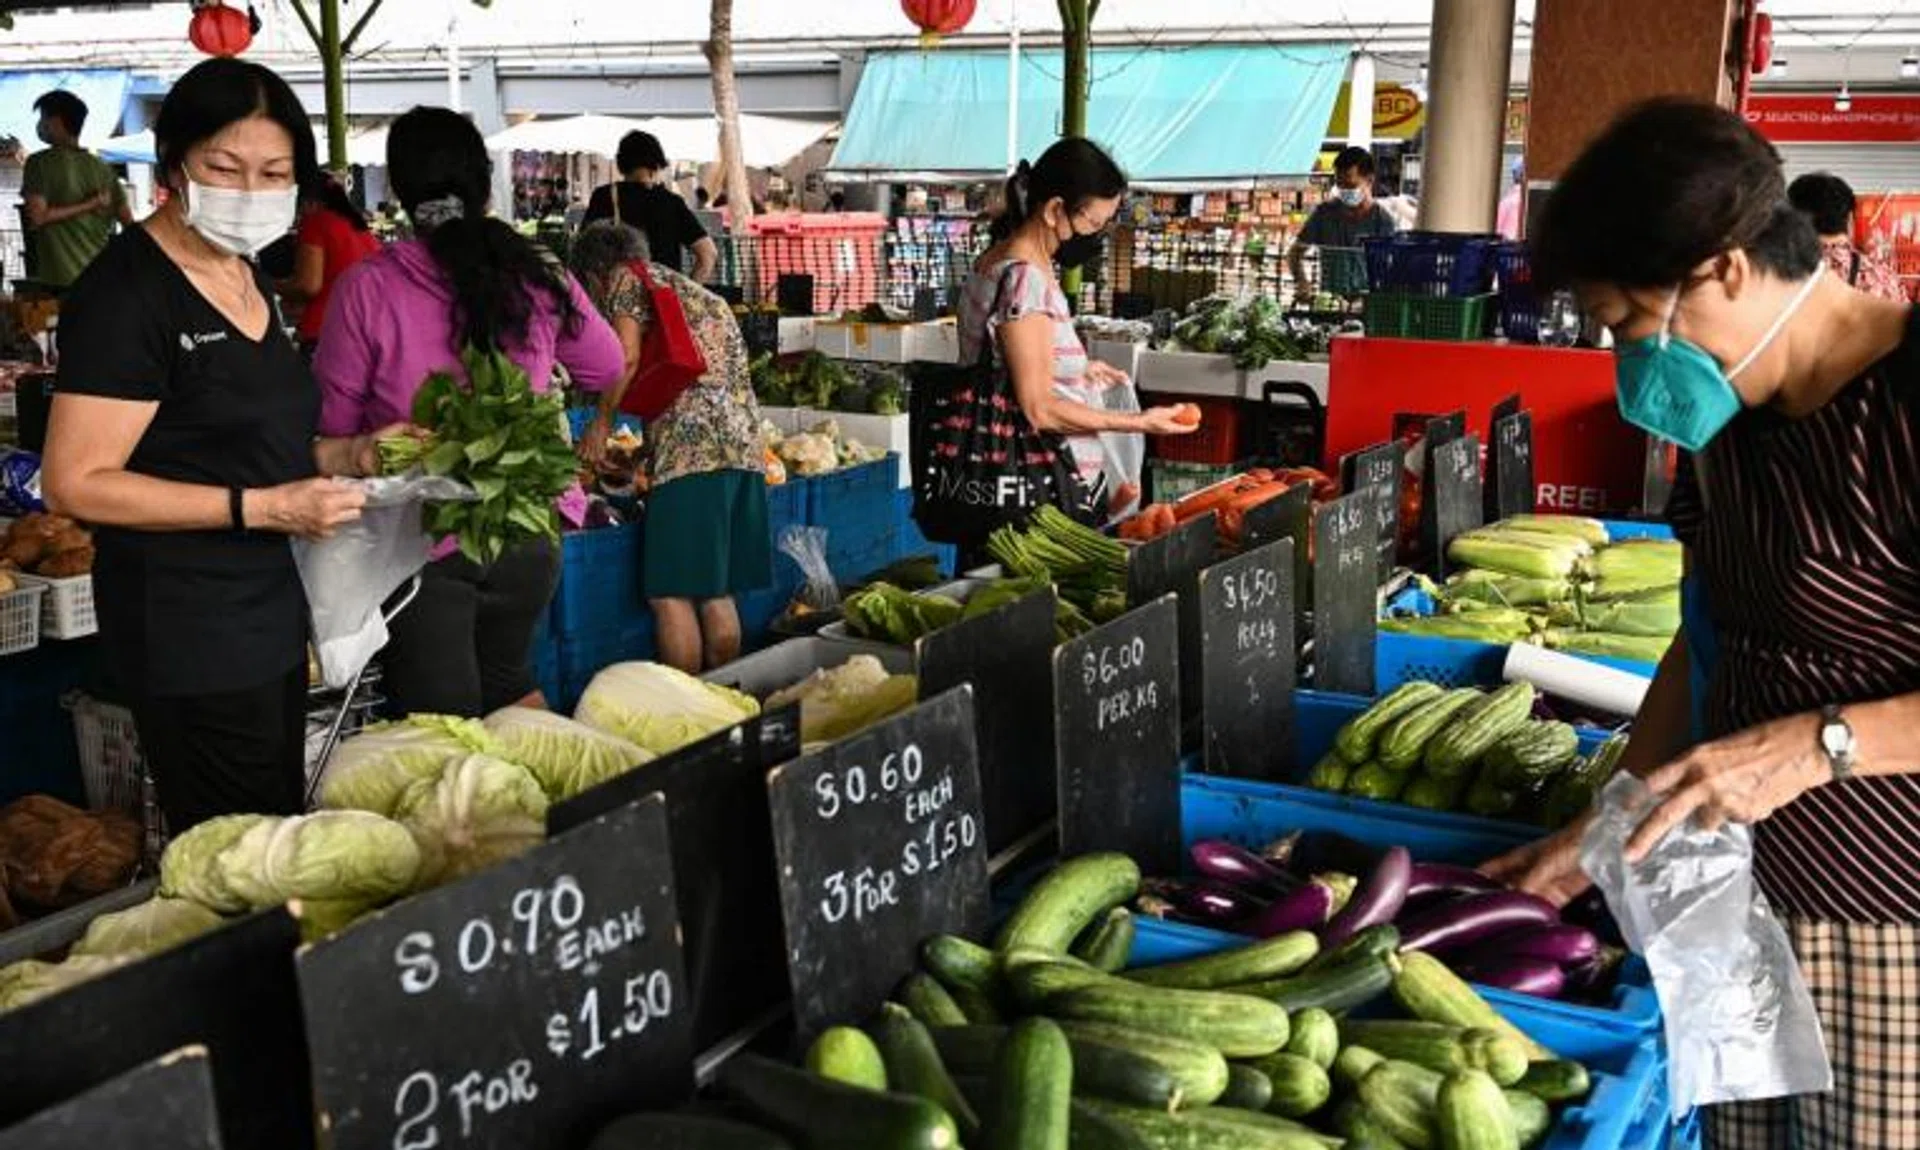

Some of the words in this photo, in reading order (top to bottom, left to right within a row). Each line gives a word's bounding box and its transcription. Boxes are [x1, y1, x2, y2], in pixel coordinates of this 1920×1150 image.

[1374, 96, 1412, 116] BC
[1764, 111, 1819, 123] SELECTED
[1082, 635, 1146, 694] $6.00
[904, 774, 953, 824] EACH
[557, 906, 646, 971] EACH
[393, 1071, 439, 1150] 2
[545, 968, 673, 1060] $1.50
